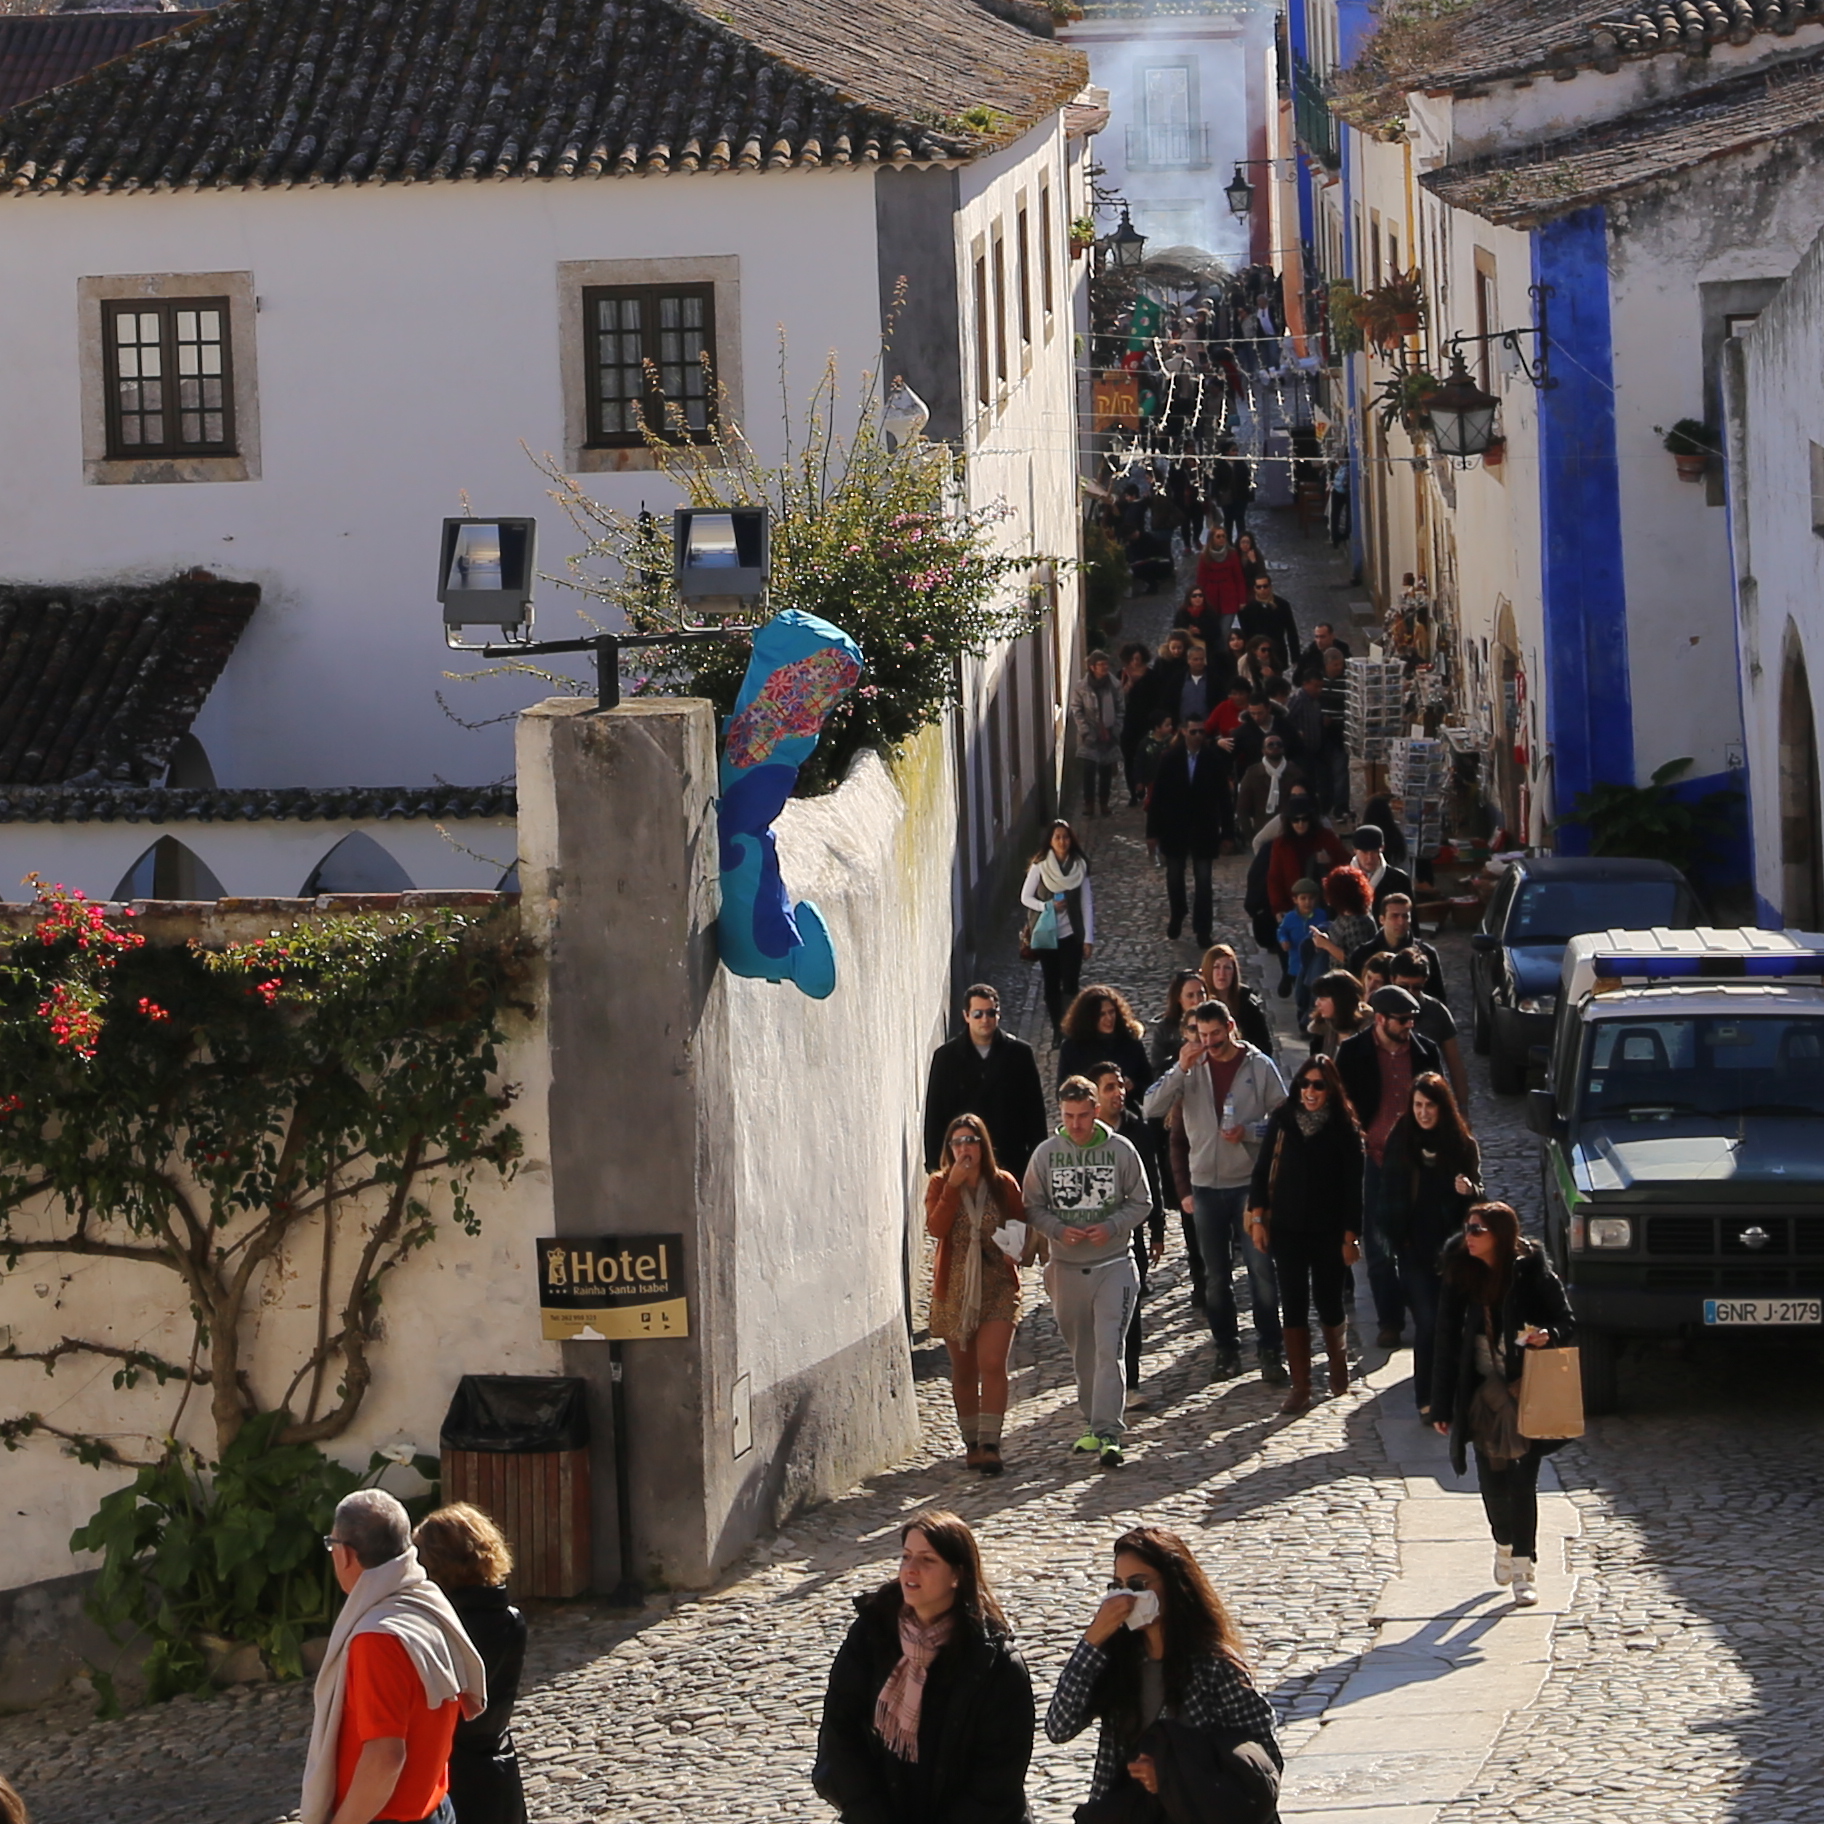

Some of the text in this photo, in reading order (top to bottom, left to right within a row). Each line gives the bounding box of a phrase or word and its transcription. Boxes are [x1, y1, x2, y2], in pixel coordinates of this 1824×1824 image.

[1049, 1150, 1116, 1167] FRANKLIN
[1052, 1169, 1077, 1188] 52
[571, 1244, 668, 1283] Hotel
[573, 1282, 669, 1296] Rainha Santa Isabel
[1716, 1303, 1757, 1322] GNR
